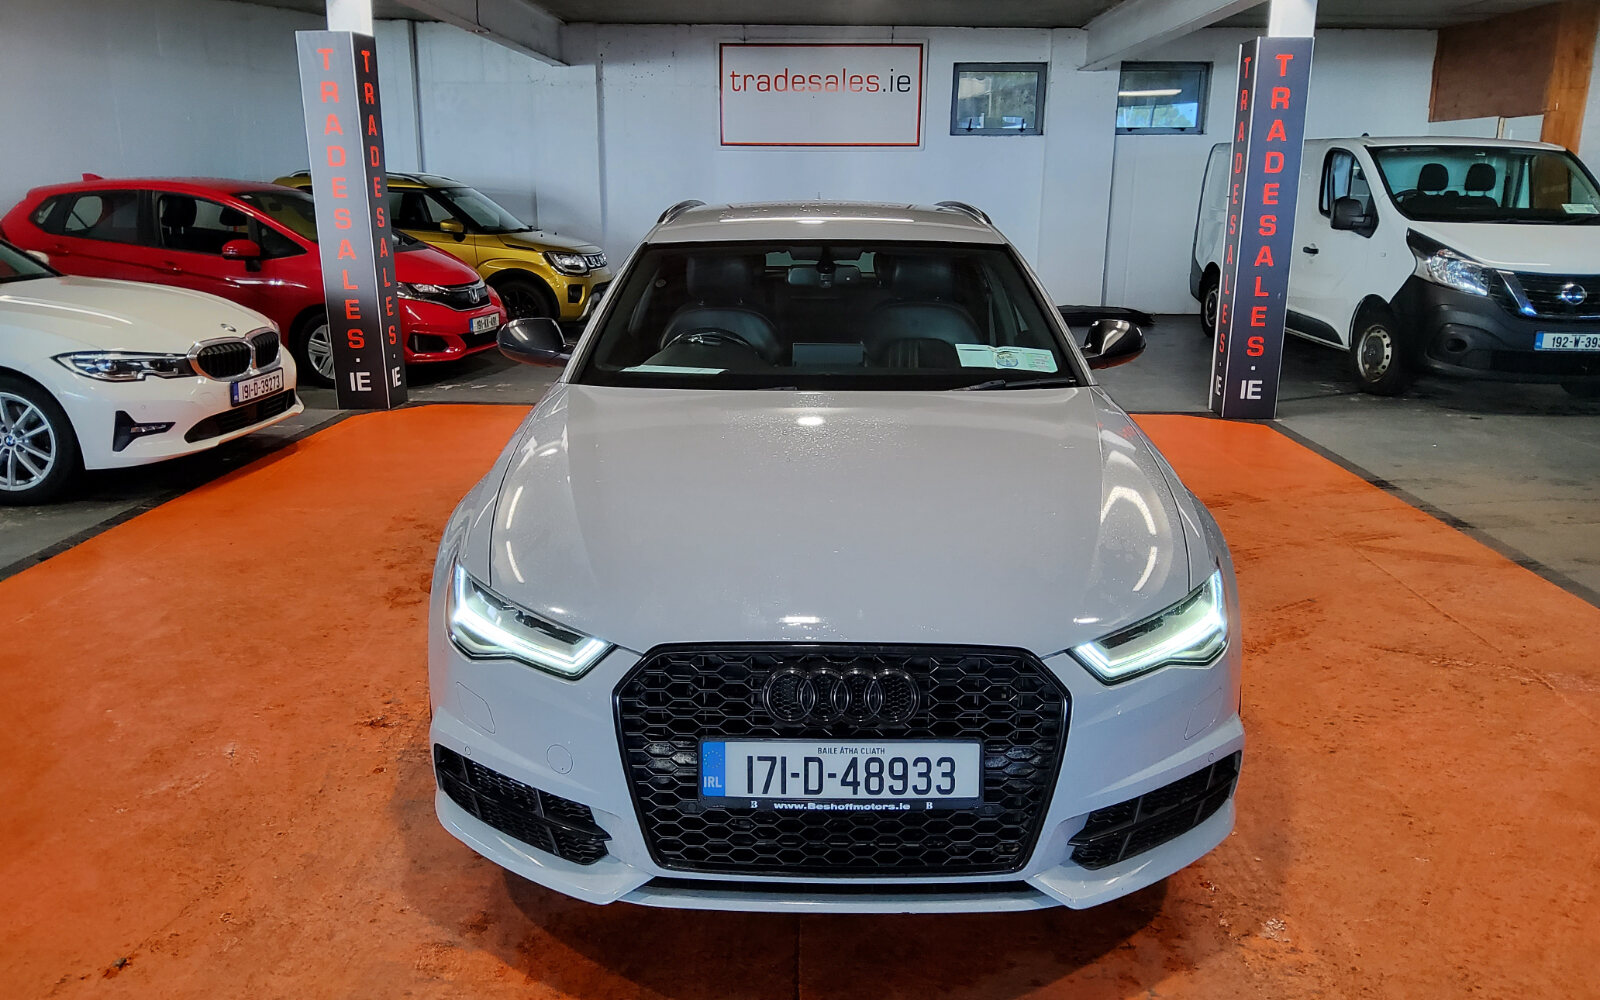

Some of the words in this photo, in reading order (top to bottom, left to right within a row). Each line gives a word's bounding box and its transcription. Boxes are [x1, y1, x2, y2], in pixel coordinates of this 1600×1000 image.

[729, 67, 911, 93] tradesales.ie
[242, 375, 280, 399] 191-D-39273
[817, 747, 838, 755] BAILE
[840, 746, 859, 755] ÁTHA
[860, 747, 886, 755] CLIATH
[703, 776, 722, 788] IRL
[746, 755, 956, 796] 171-D-48933
[773, 801, 911, 811] www.Beshoffmotors.ie
